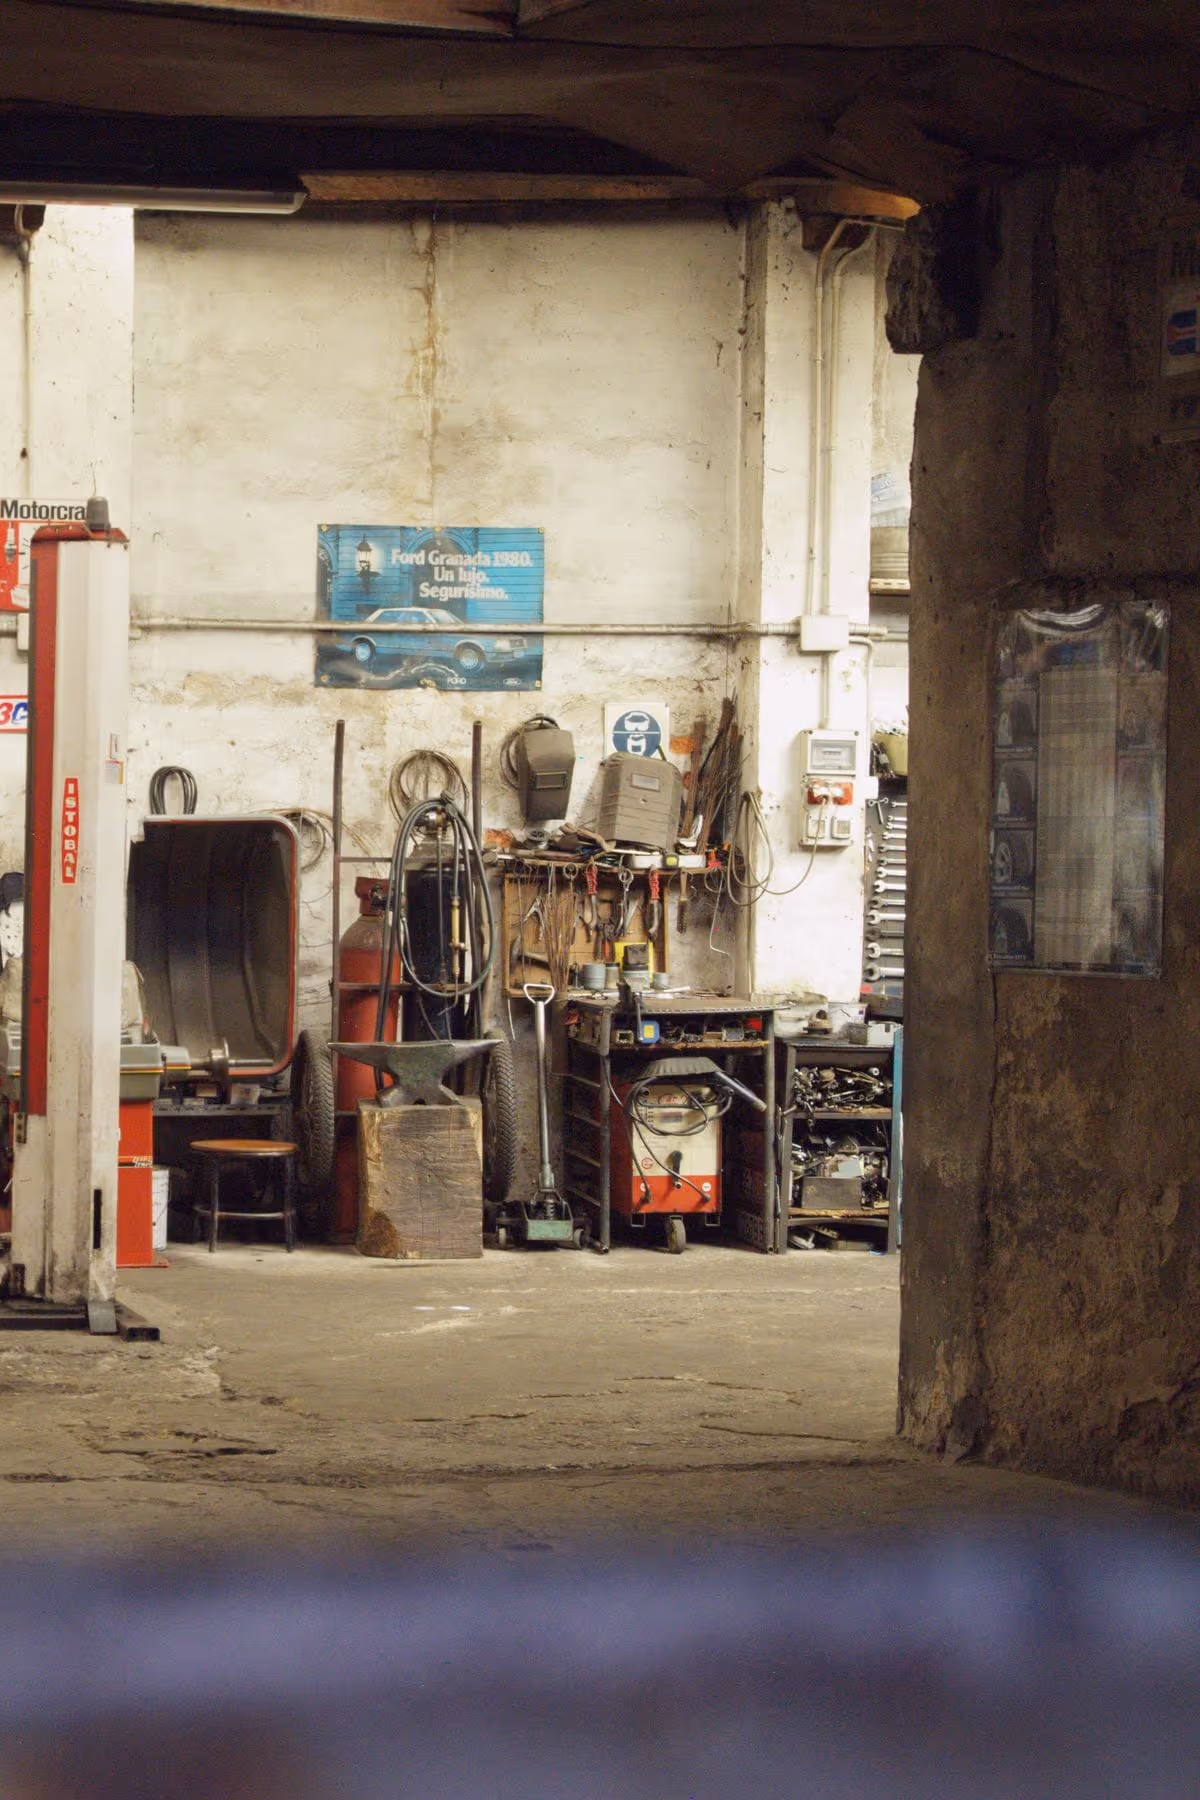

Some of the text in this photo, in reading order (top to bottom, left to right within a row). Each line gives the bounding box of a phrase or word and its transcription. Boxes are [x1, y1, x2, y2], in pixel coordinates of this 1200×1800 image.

[0, 499, 86, 521] Motorcra
[391, 549, 425, 566] Ford
[428, 549, 491, 567] Granada
[434, 567, 490, 585] Un lujo.
[64, 780, 79, 881] ISTOBAL
